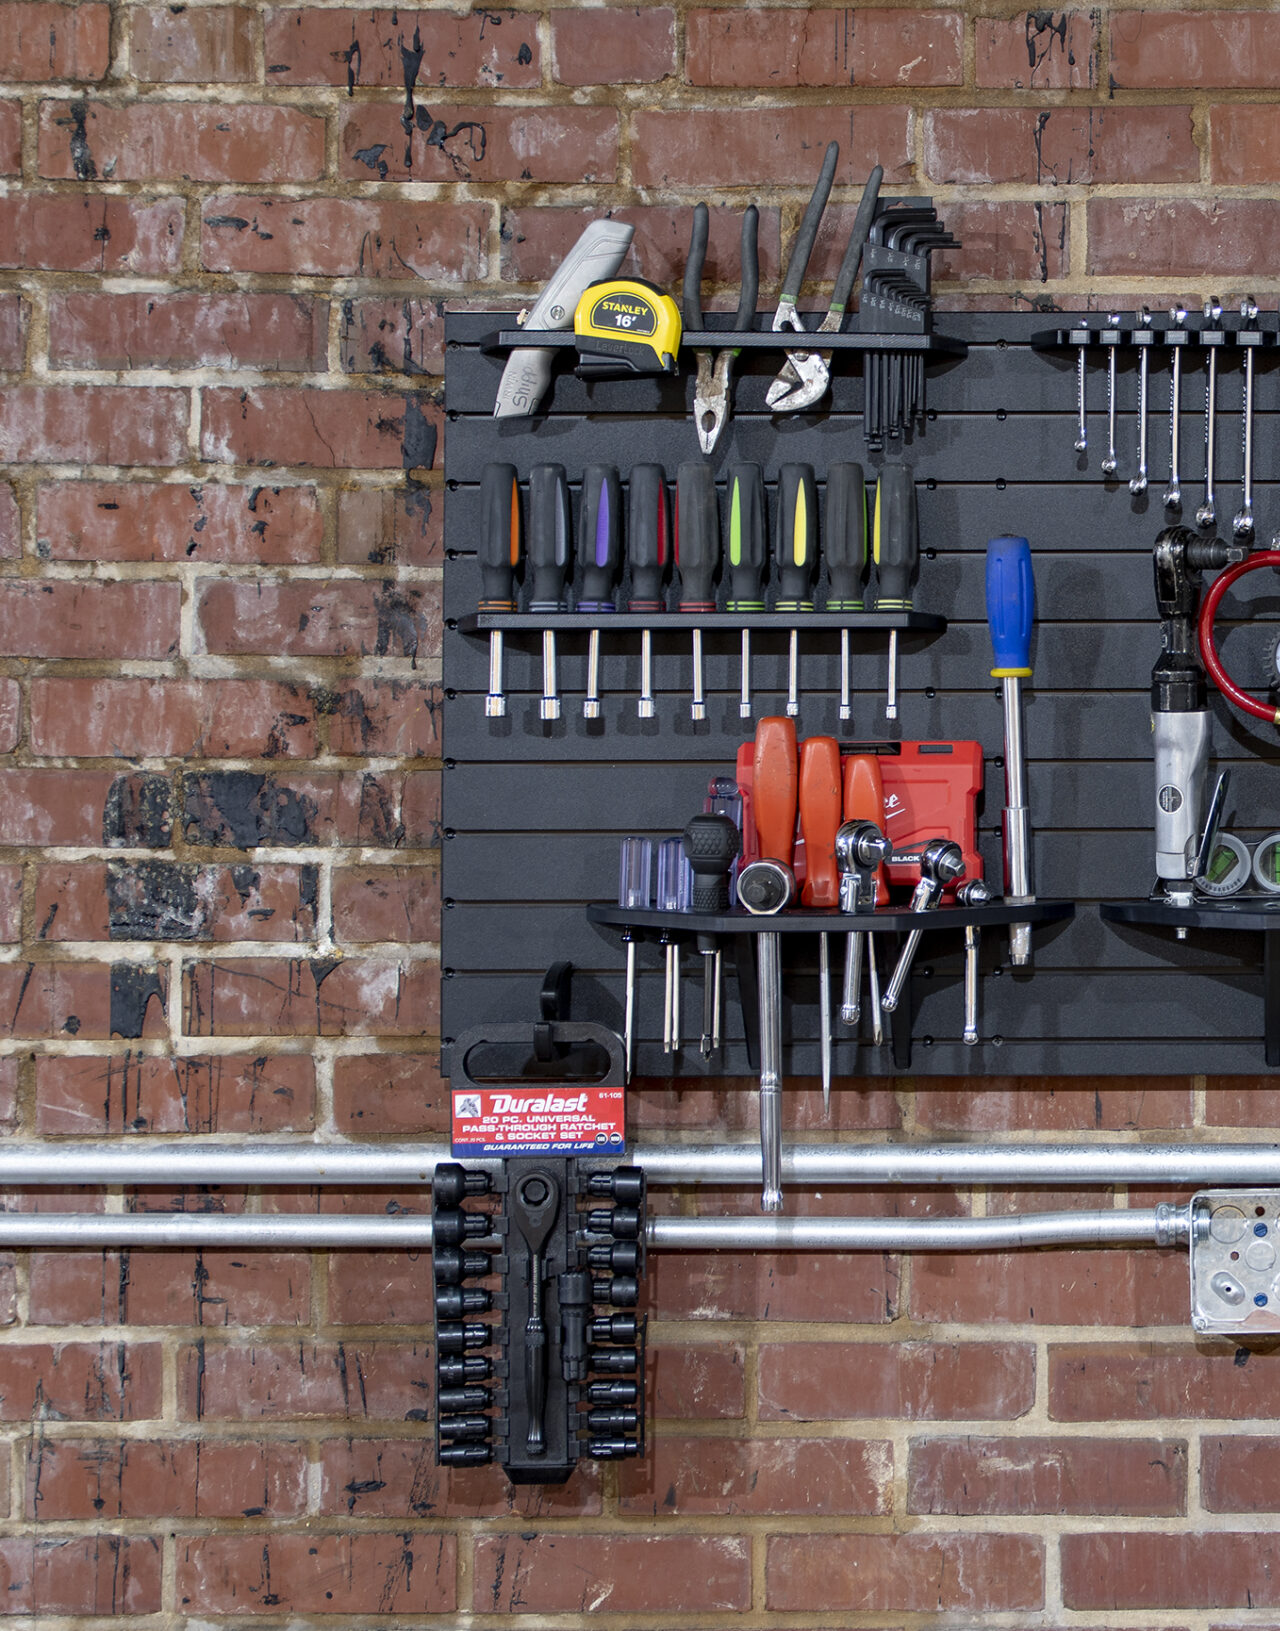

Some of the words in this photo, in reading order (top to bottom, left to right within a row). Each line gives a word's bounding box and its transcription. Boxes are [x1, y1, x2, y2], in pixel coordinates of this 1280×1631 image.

[602, 301, 648, 316] STANLEY
[489, 1093, 588, 1113] Duralast
[482, 1116, 498, 1124] 20
[502, 1116, 522, 1124] PC.
[527, 1115, 595, 1123] UNIVERSAL
[462, 1124, 557, 1132] PASS-THROUGH
[560, 1123, 616, 1131] RATCHET
[495, 1133, 504, 1141] &
[507, 1132, 556, 1141] SOCKET
[560, 1131, 583, 1139] SET
[483, 1143, 549, 1151] GUARANTEED
